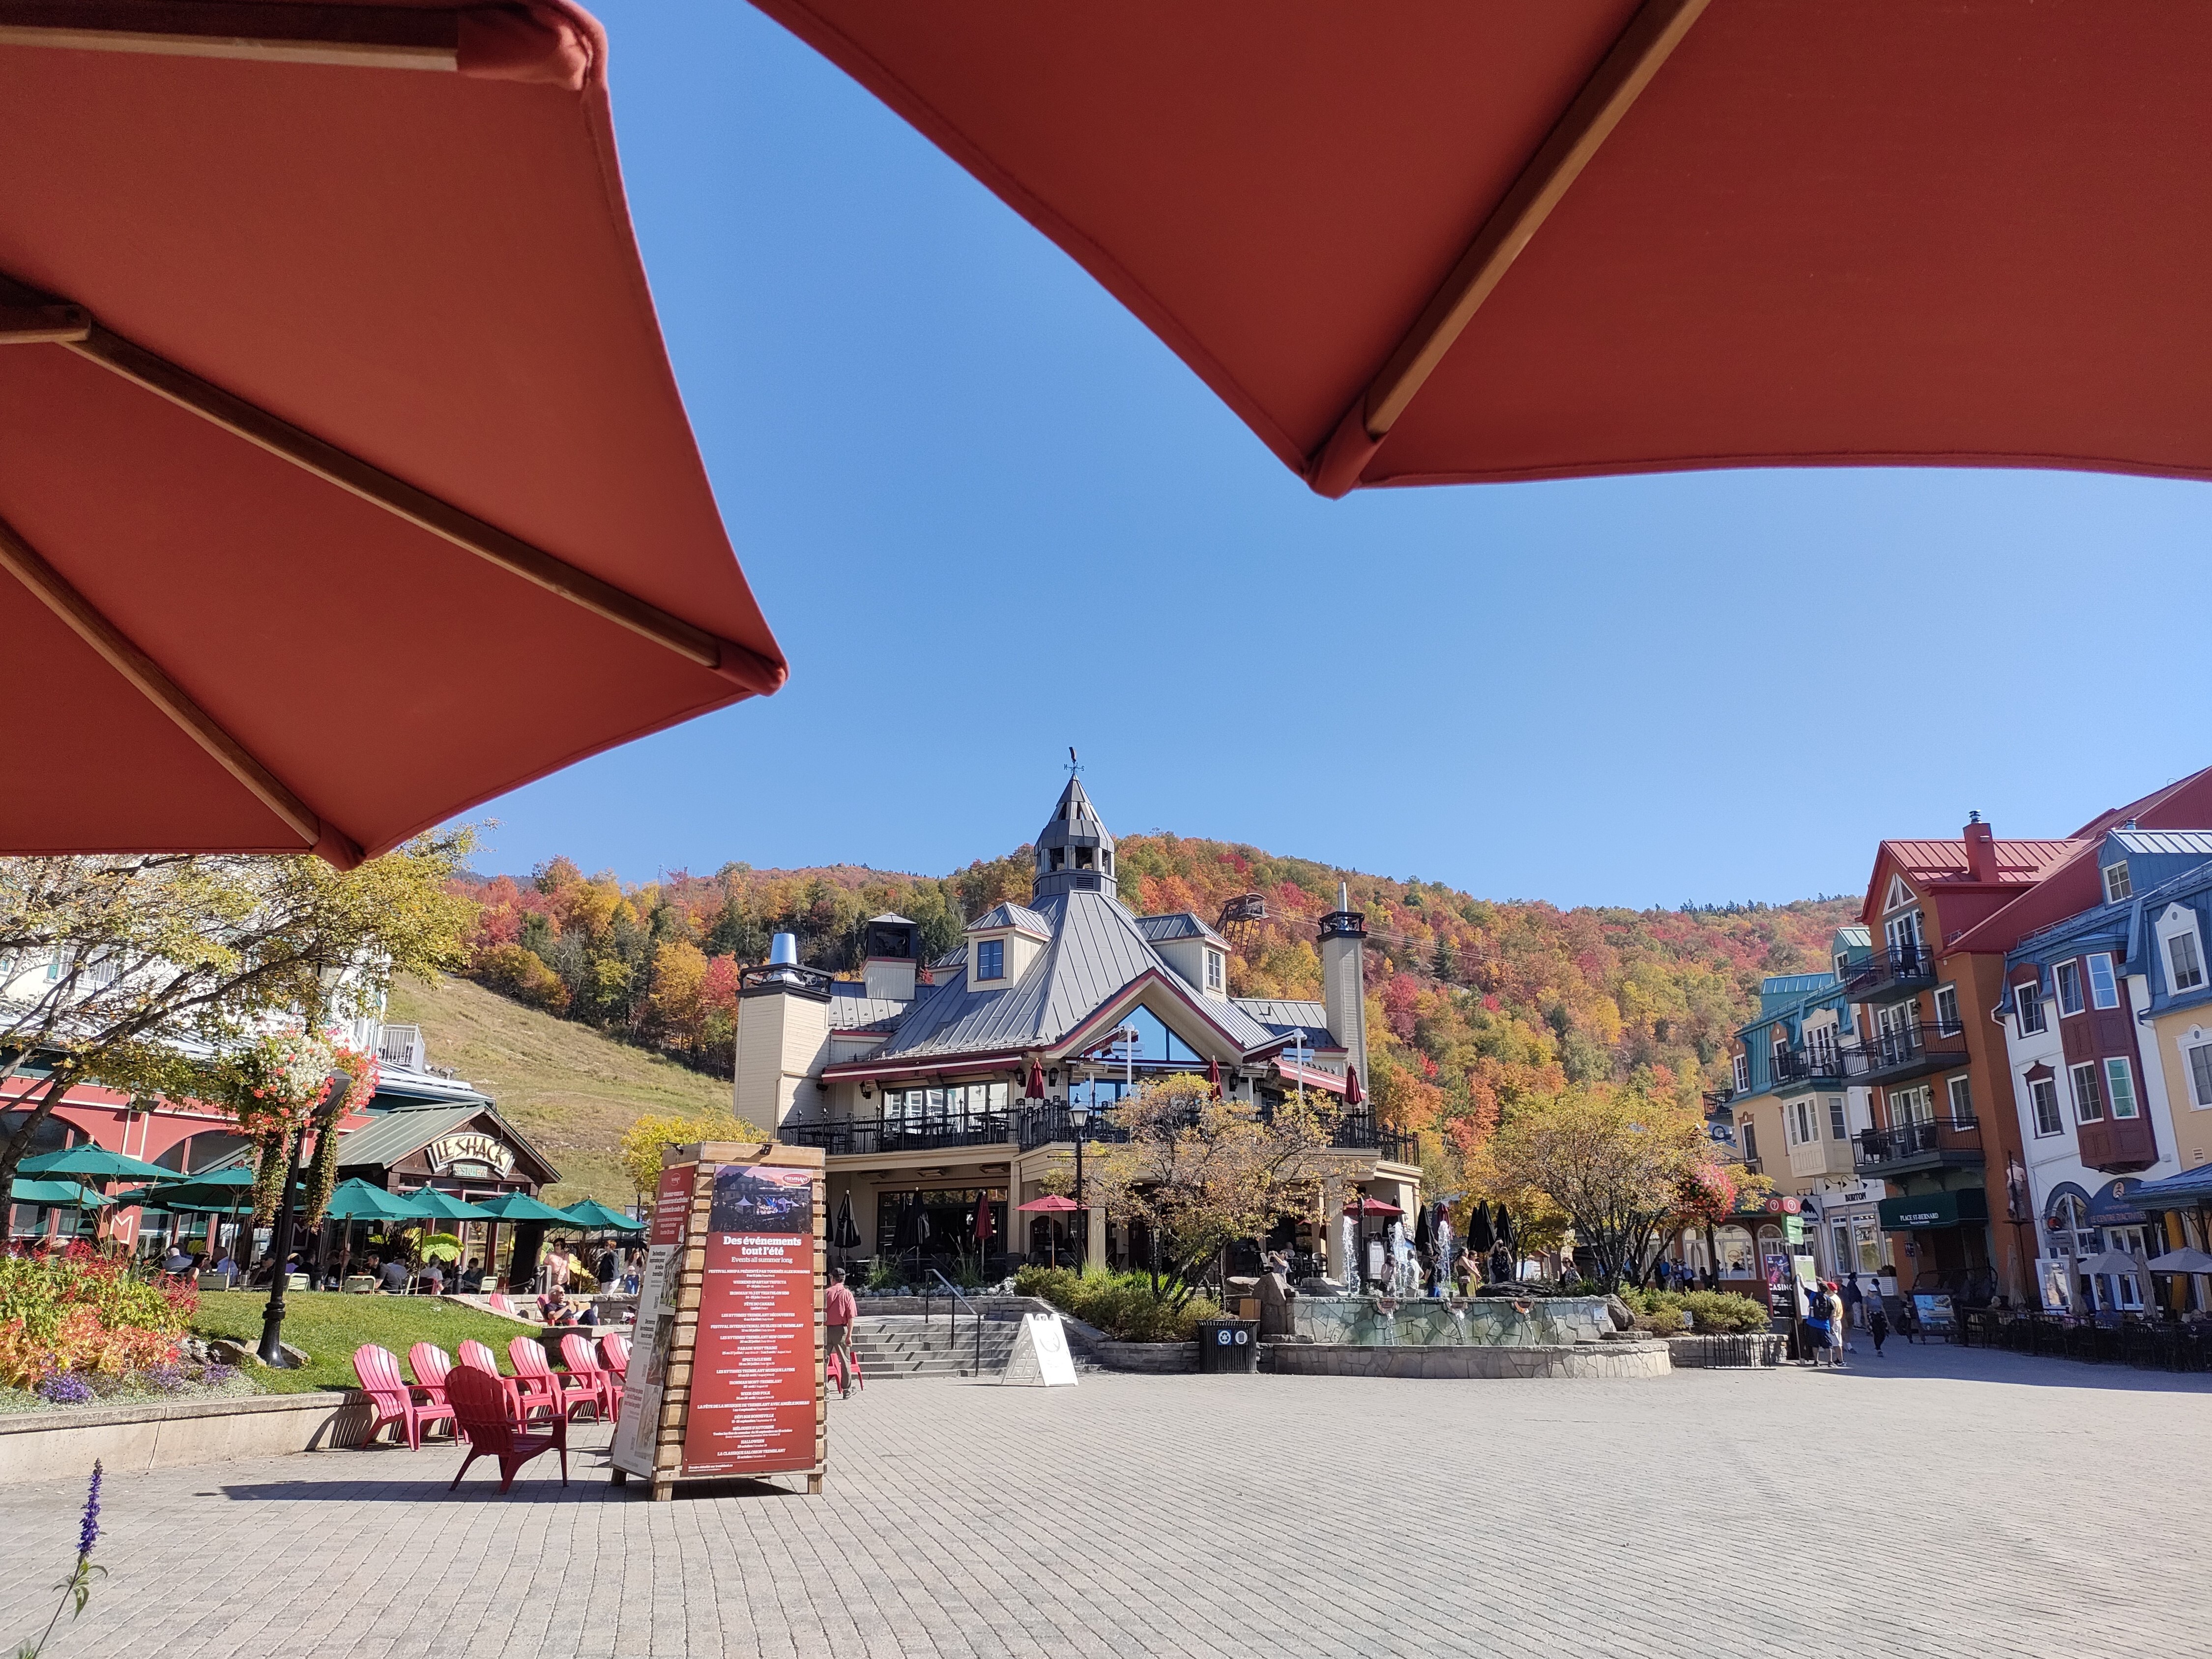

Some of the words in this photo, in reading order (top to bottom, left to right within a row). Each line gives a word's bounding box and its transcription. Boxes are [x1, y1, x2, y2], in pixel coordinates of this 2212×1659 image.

[437, 1138, 455, 1162] LE
[455, 1136, 510, 1166] SHACK
[454, 1165, 473, 1175] RESTO
[476, 1167, 487, 1177] BAR
[1845, 1192, 1866, 1202] BURTON
[1913, 1212, 1939, 1221] ST-BERNARD
[723, 1236, 743, 1245] Des
[743, 1236, 802, 1246] événements
[742, 1247, 763, 1255] tout
[763, 1247, 784, 1256] l'été
